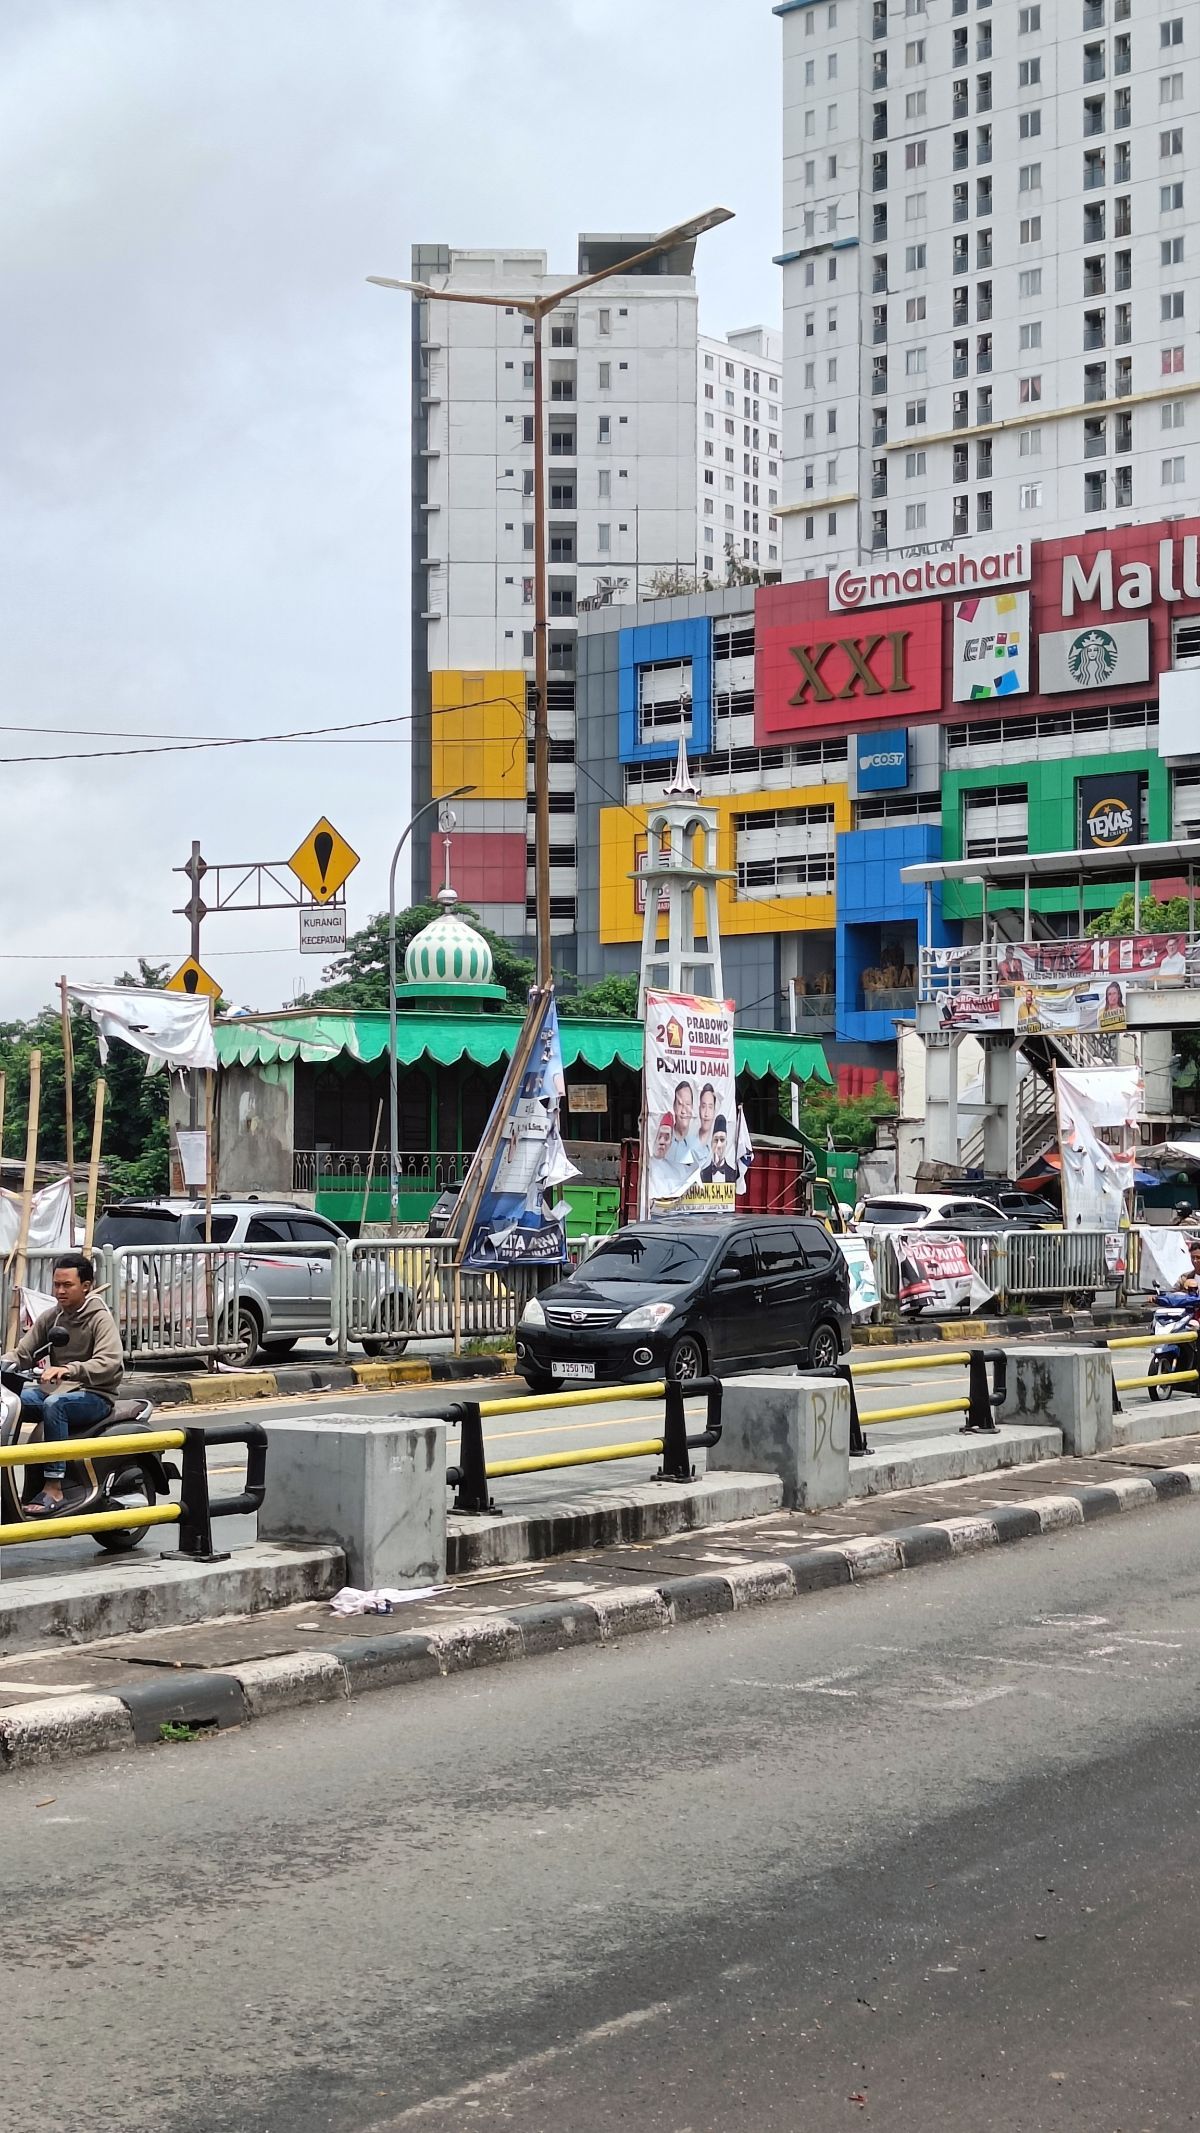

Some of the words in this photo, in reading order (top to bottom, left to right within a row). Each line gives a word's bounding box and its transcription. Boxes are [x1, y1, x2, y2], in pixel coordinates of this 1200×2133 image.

[869, 543, 1024, 599] matahari
[1061, 535, 1200, 617] Mall
[962, 635, 996, 662] EF
[788, 630, 914, 706] XXI
[1086, 809, 1132, 838] TEXAS
[303, 917, 342, 928] KURANGI
[301, 935, 345, 945] KECEPATAN
[1090, 940, 1110, 971] 11
[655, 1024, 666, 1042] 2
[686, 1016, 729, 1032] PRABOWO
[688, 1031, 721, 1046] GIBRAN
[700, 1060, 729, 1078] DAMAI
